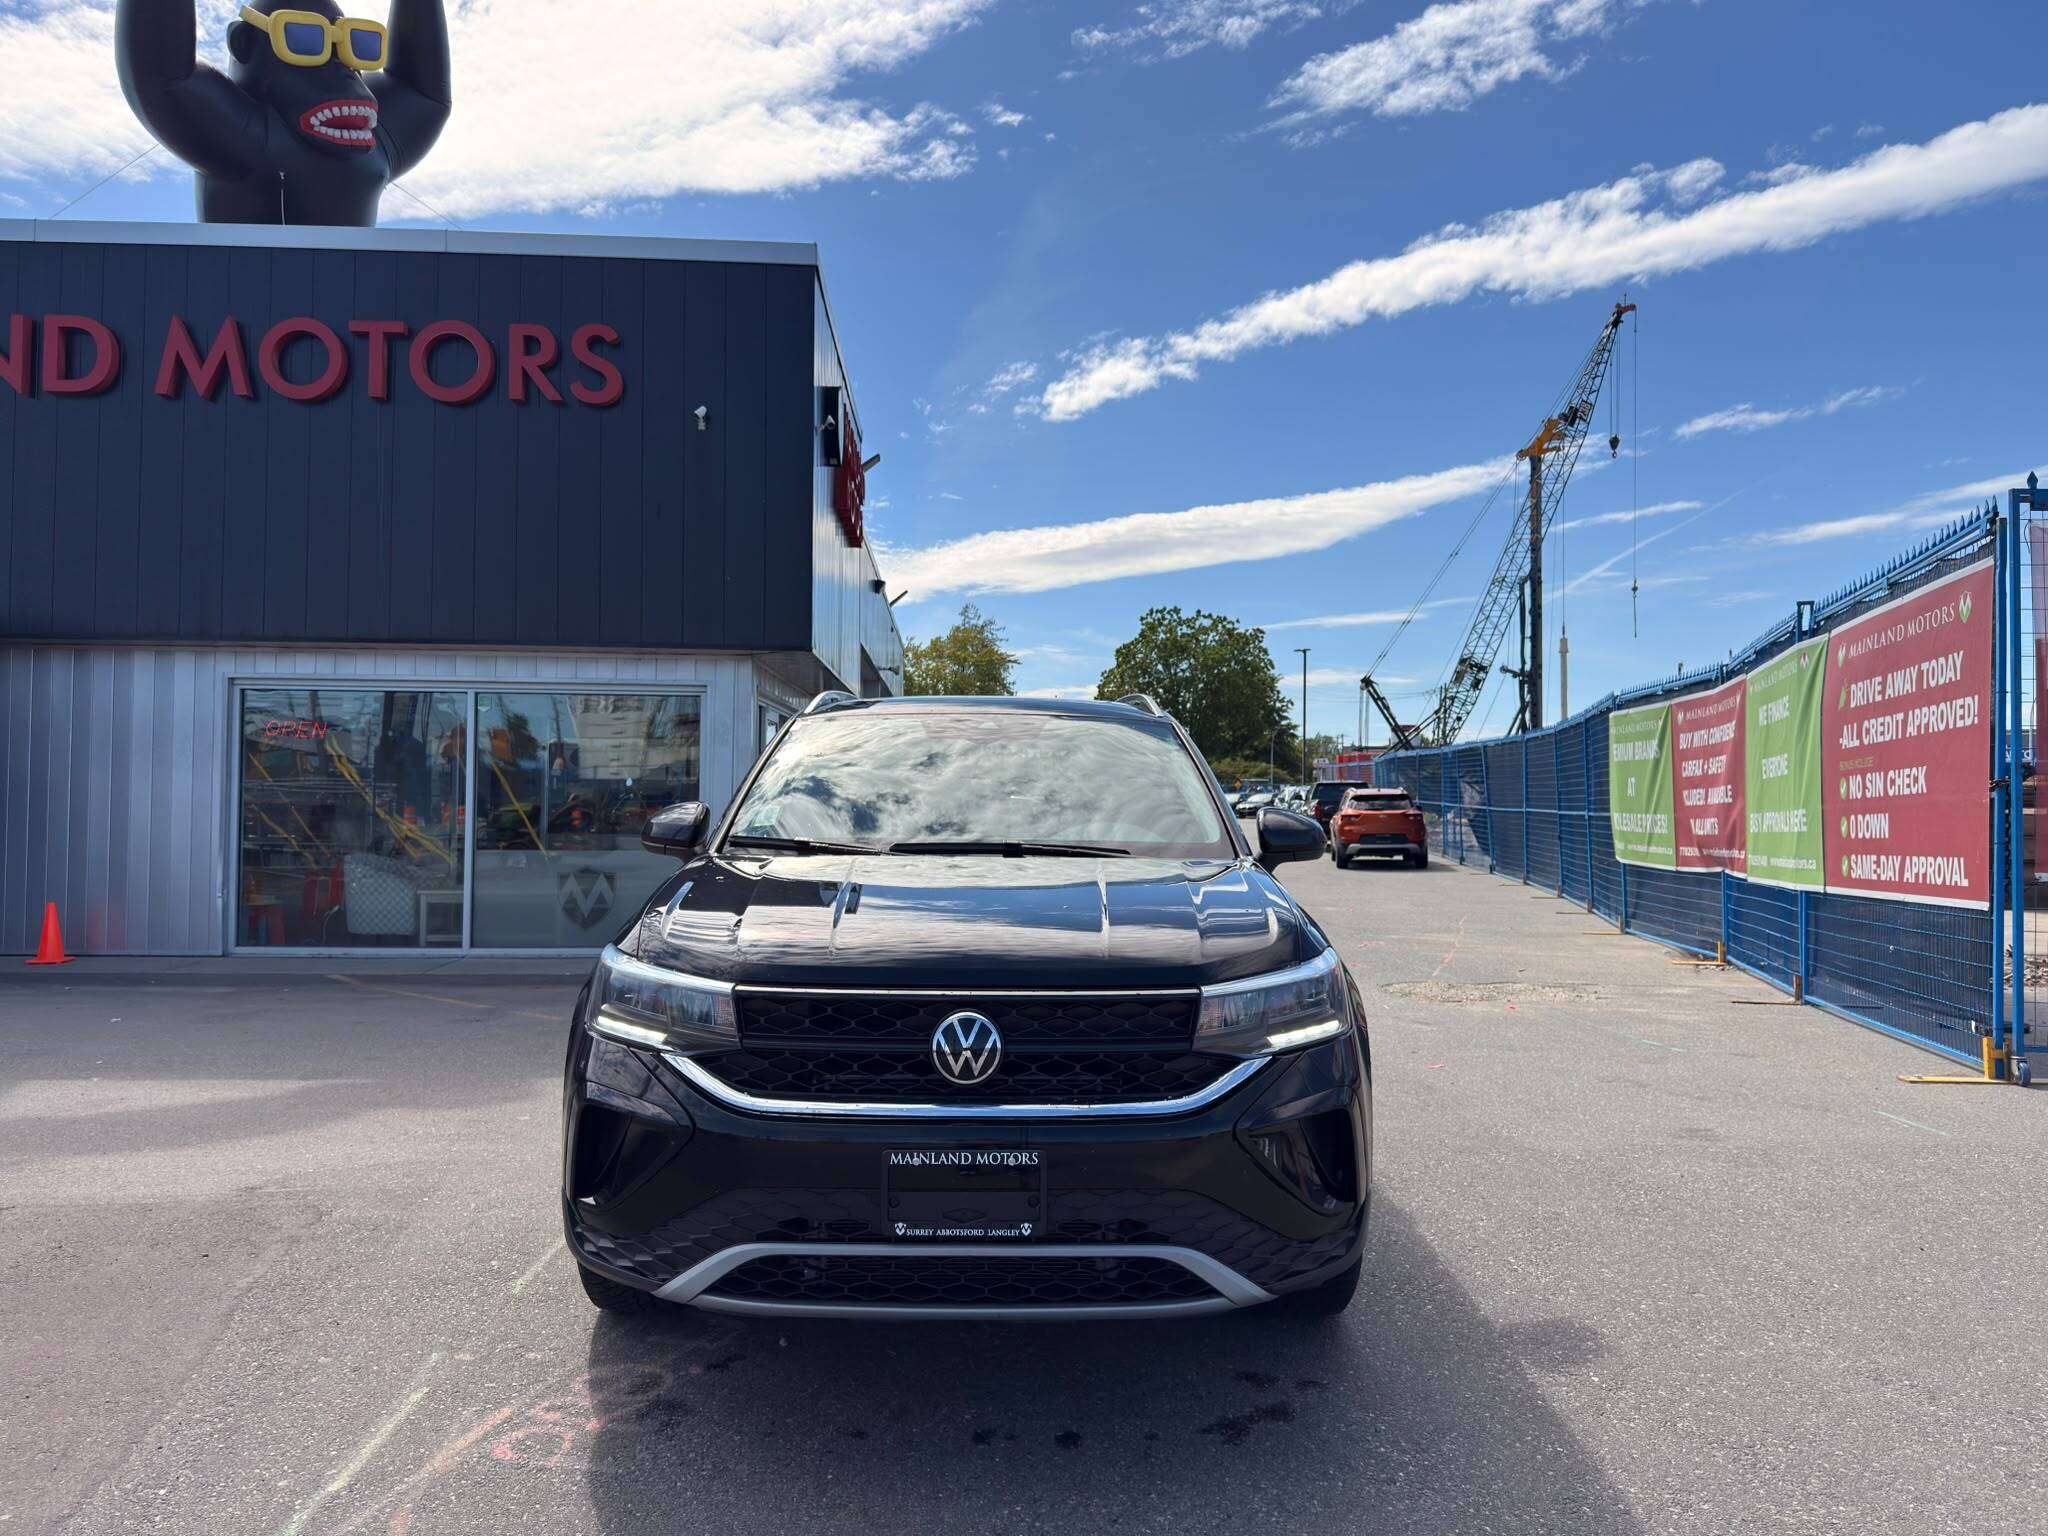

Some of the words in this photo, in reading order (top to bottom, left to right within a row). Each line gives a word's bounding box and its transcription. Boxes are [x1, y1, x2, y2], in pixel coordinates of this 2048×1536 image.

[155, 314, 624, 406] MOTORS
[1848, 624, 1905, 659] MAINLAND
[1907, 602, 1956, 638] MOTORS
[1850, 675, 1883, 708] DRIVE
[1885, 664, 1919, 700] AWAY
[1920, 650, 1964, 689] TODAY
[264, 719, 329, 739] OPEN
[1863, 712, 1904, 745] CREDIT
[1906, 694, 1979, 738] APPROVED!
[1679, 732, 1693, 750] BUY
[1693, 728, 1708, 748] WITH
[1682, 759, 1703, 778] CARFAX
[1708, 755, 1728, 775] SAFETY
[1627, 777, 1636, 797] AT
[1849, 773, 1863, 800] NO
[1865, 771, 1884, 798] SIN
[1887, 765, 1927, 797] CHECK
[1850, 814, 1856, 839] 0
[1858, 813, 1889, 839] DOWN
[1850, 854, 1901, 882] SAME-DAY
[1903, 856, 1969, 887] APPROVAL
[889, 1152, 972, 1165] MAINLAND
[975, 1152, 1039, 1165] MOTORS
[906, 1228, 934, 1236] SURREY
[936, 1228, 984, 1236] ABBOTSFORD
[987, 1228, 1020, 1237] LANGLEY
